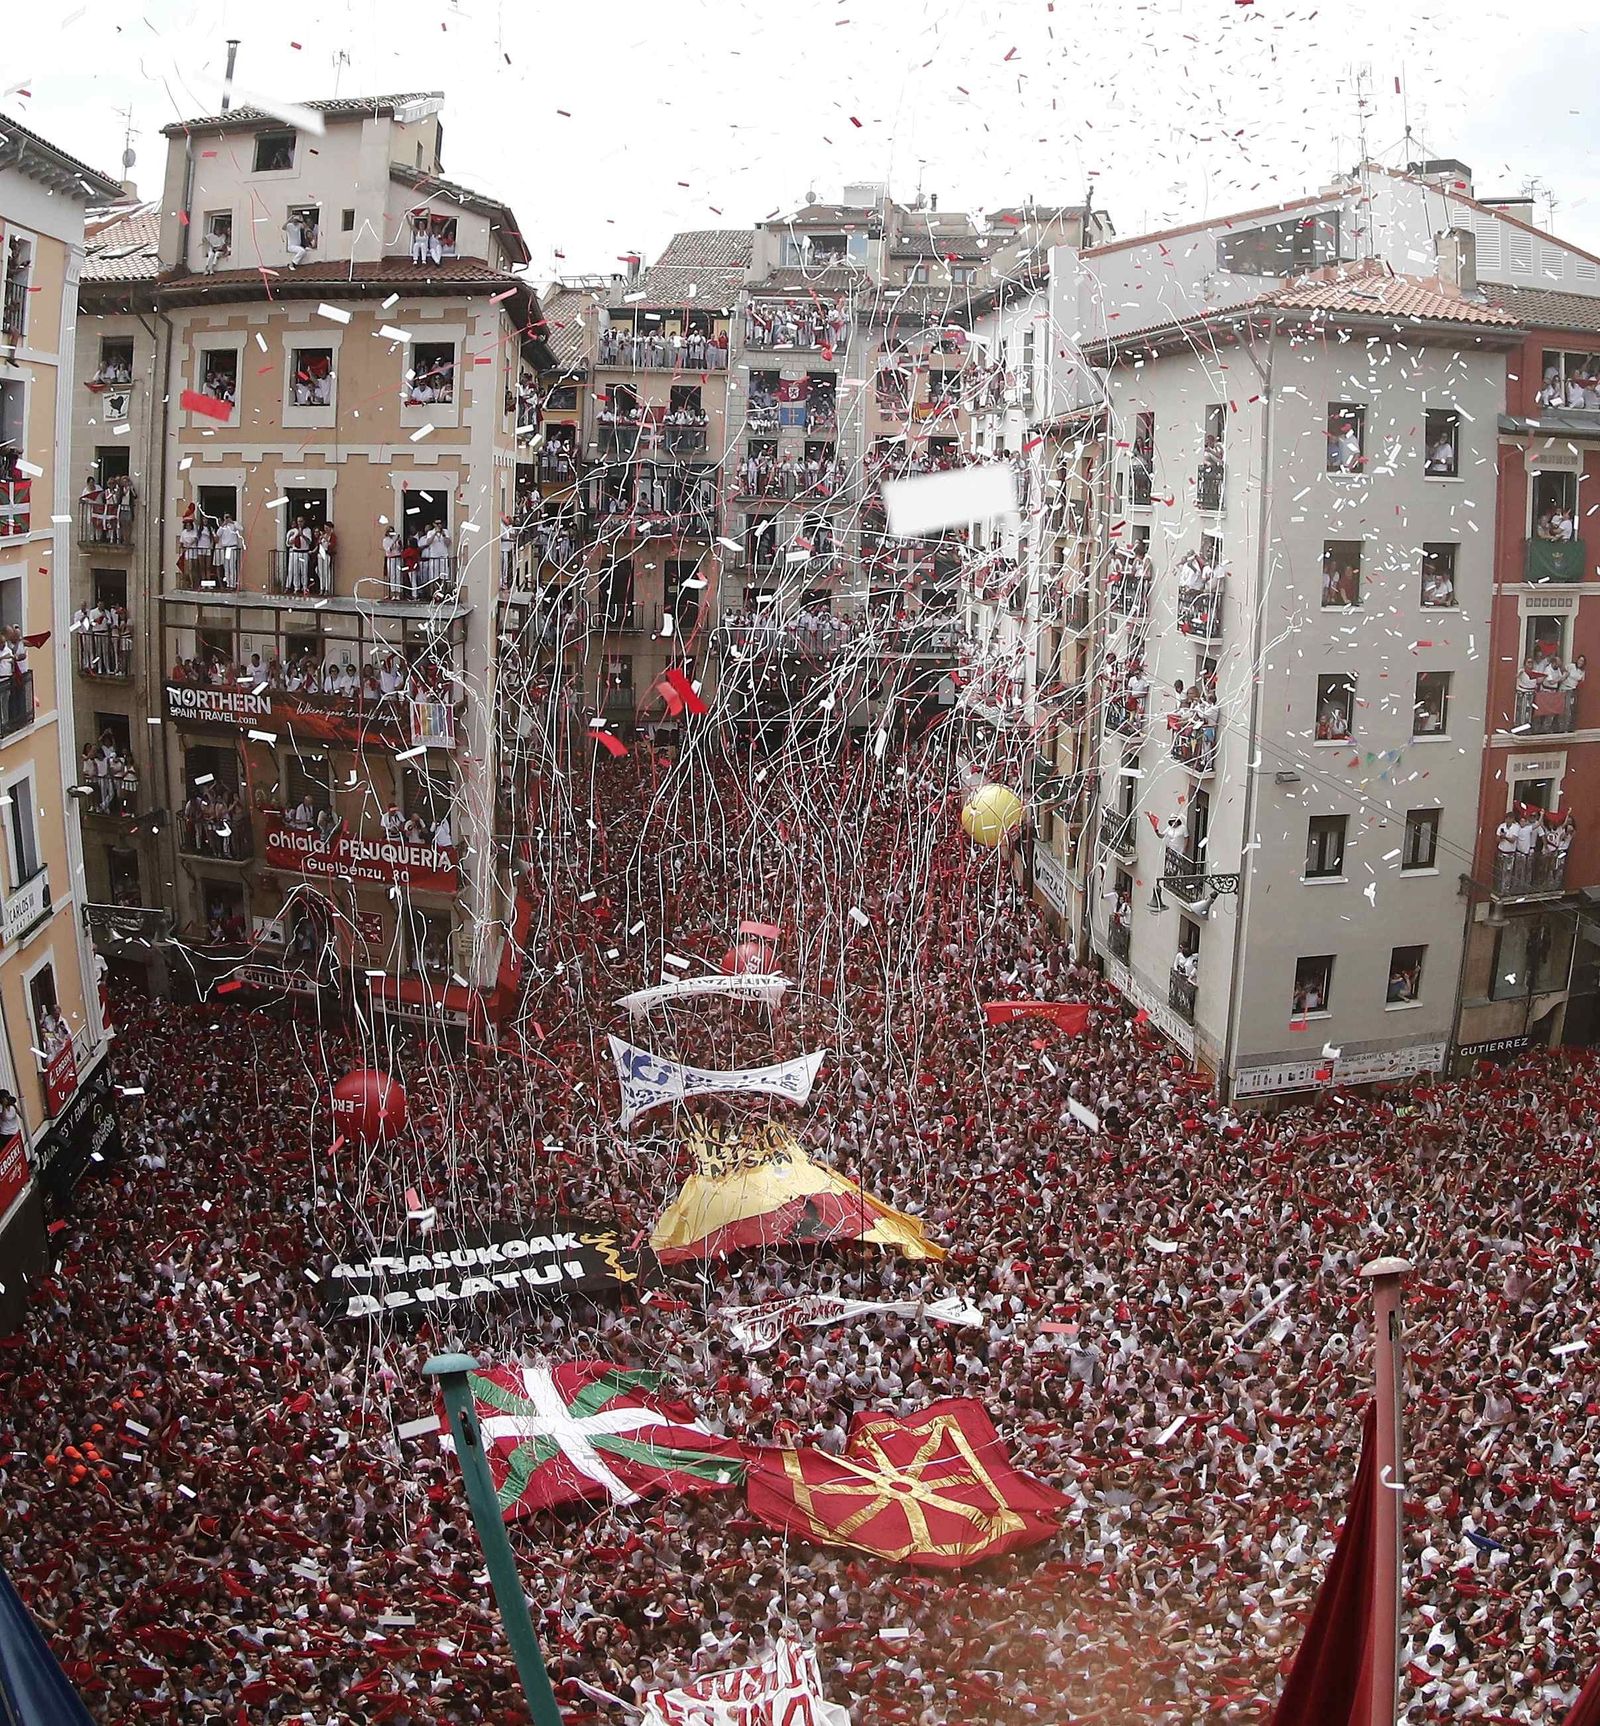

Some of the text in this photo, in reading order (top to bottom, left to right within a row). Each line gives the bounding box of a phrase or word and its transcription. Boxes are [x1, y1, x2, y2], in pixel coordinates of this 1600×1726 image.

[168, 687, 272, 715] NORTHERN
[169, 706, 197, 719] SPAIN
[268, 830, 331, 854] ohlala!
[306, 858, 386, 882] Guelbenzu,
[1460, 1037, 1529, 1057] GUTIERREZ
